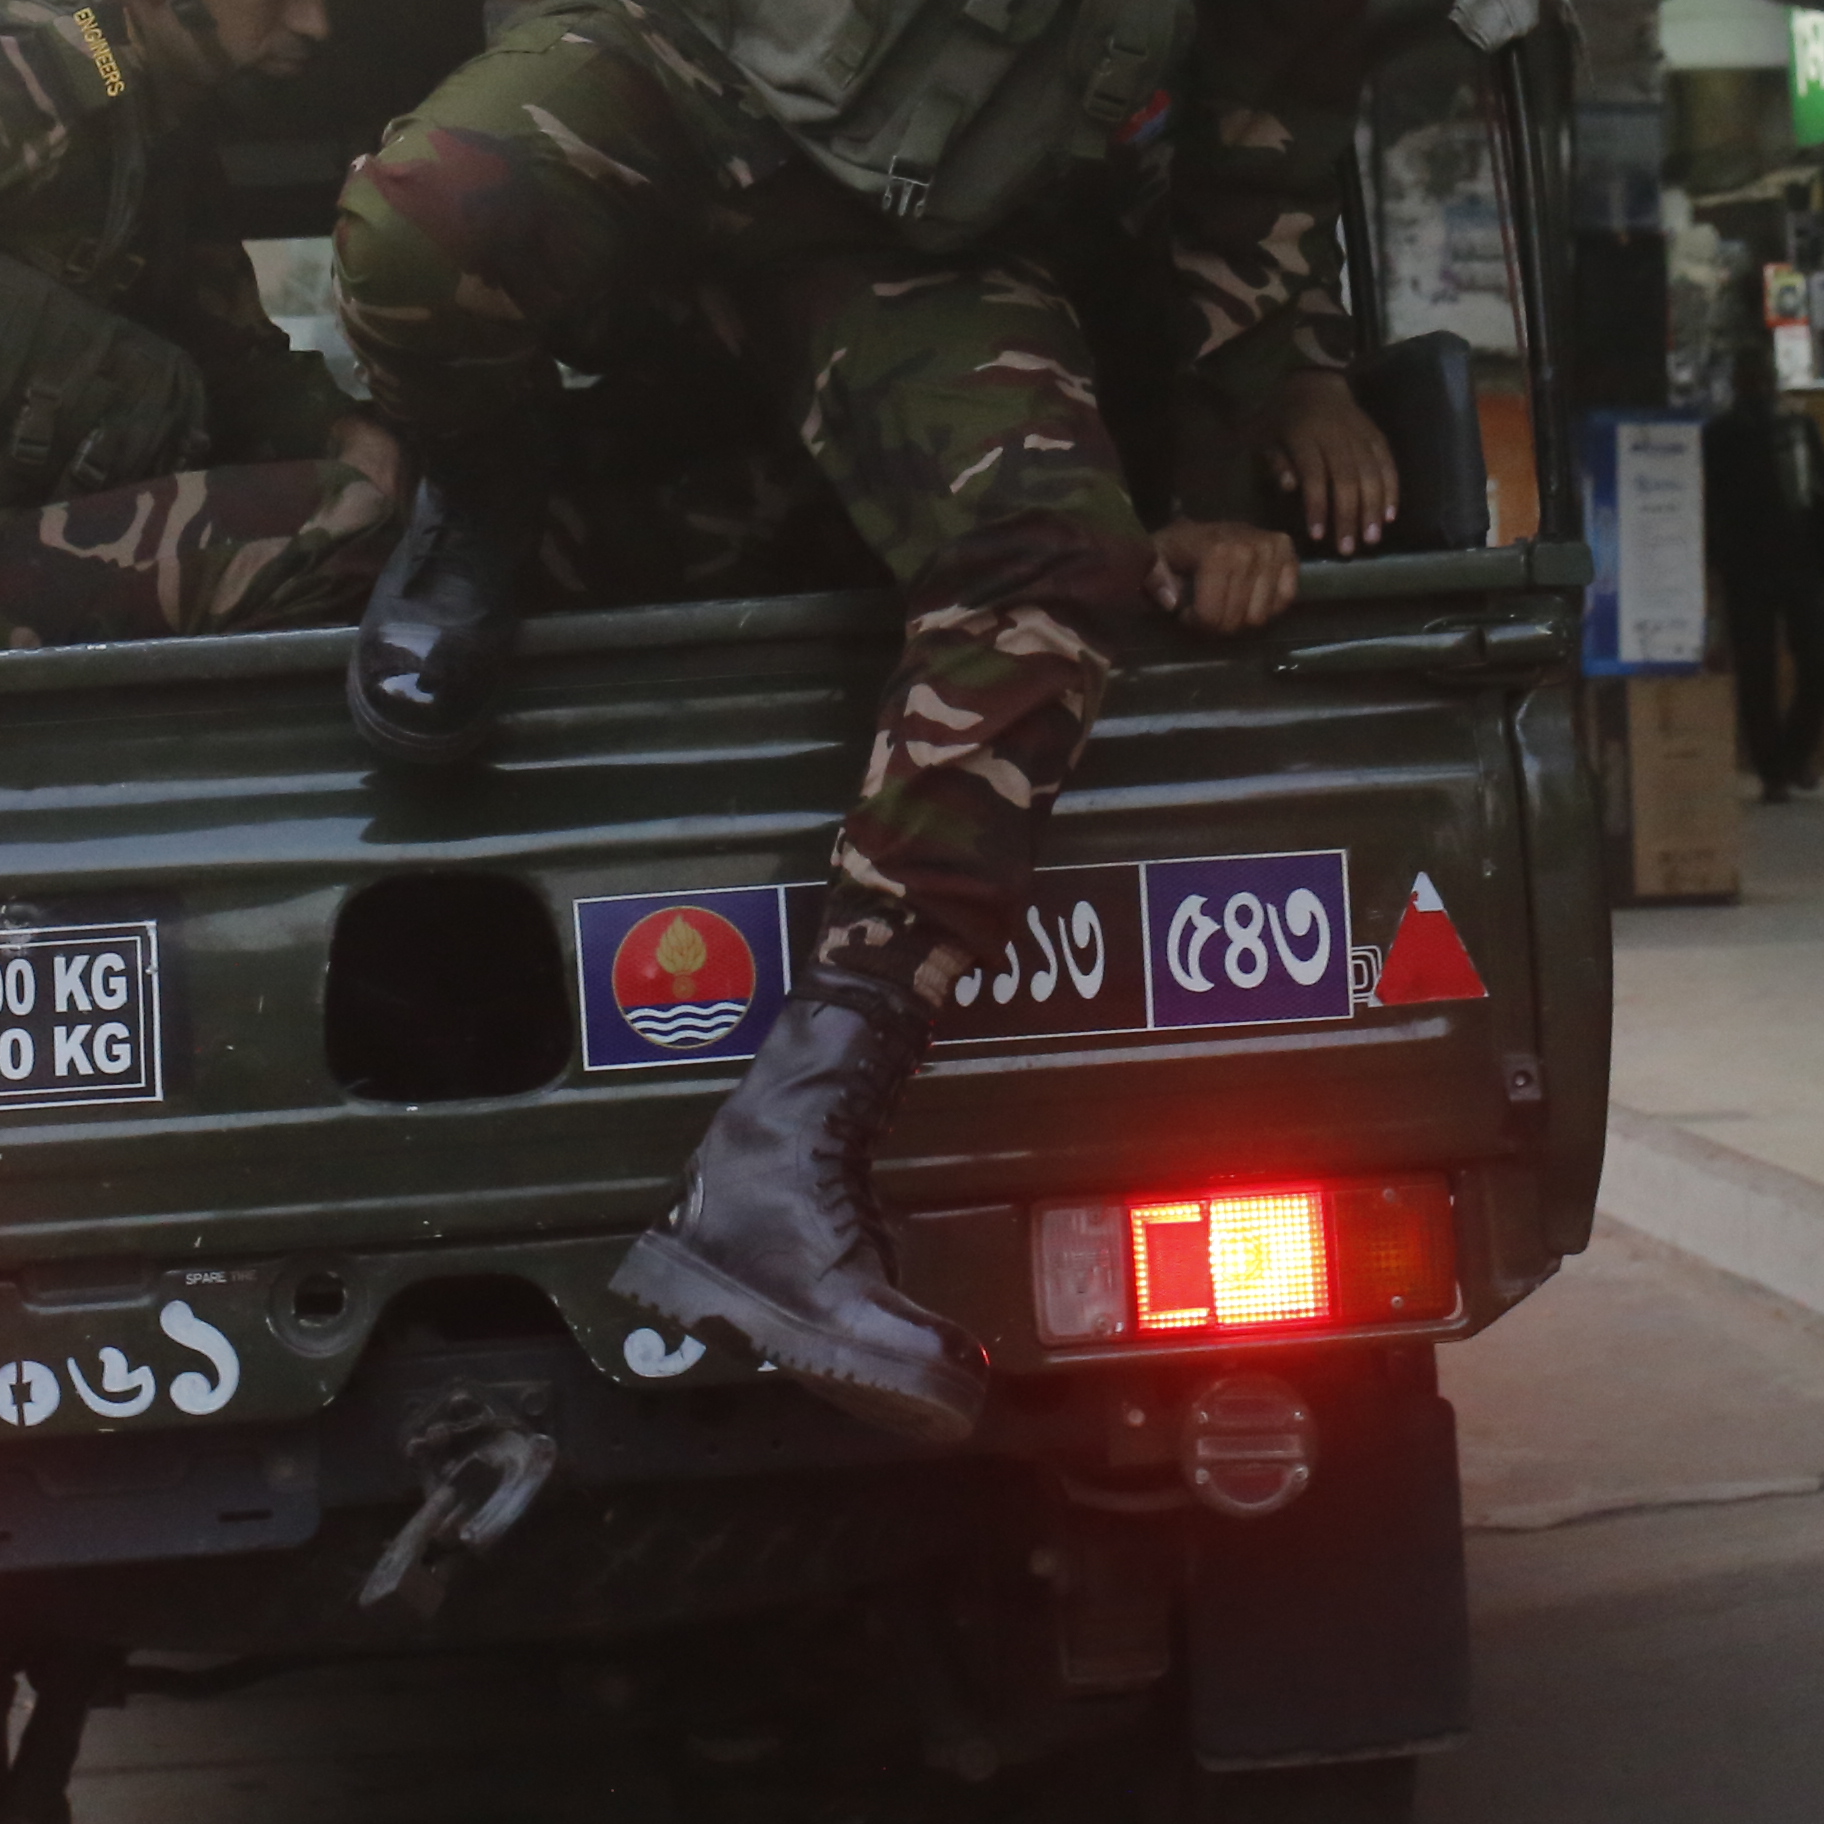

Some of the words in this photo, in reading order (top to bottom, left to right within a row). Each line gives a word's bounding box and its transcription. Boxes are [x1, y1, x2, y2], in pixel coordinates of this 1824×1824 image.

[73, 7, 125, 96] ENGINEERS
[1166, 888, 1332, 994] ৫৪৩
[53, 952, 128, 1014] KG
[53, 1022, 132, 1077] KG
[185, 1271, 227, 1286] SPARE
